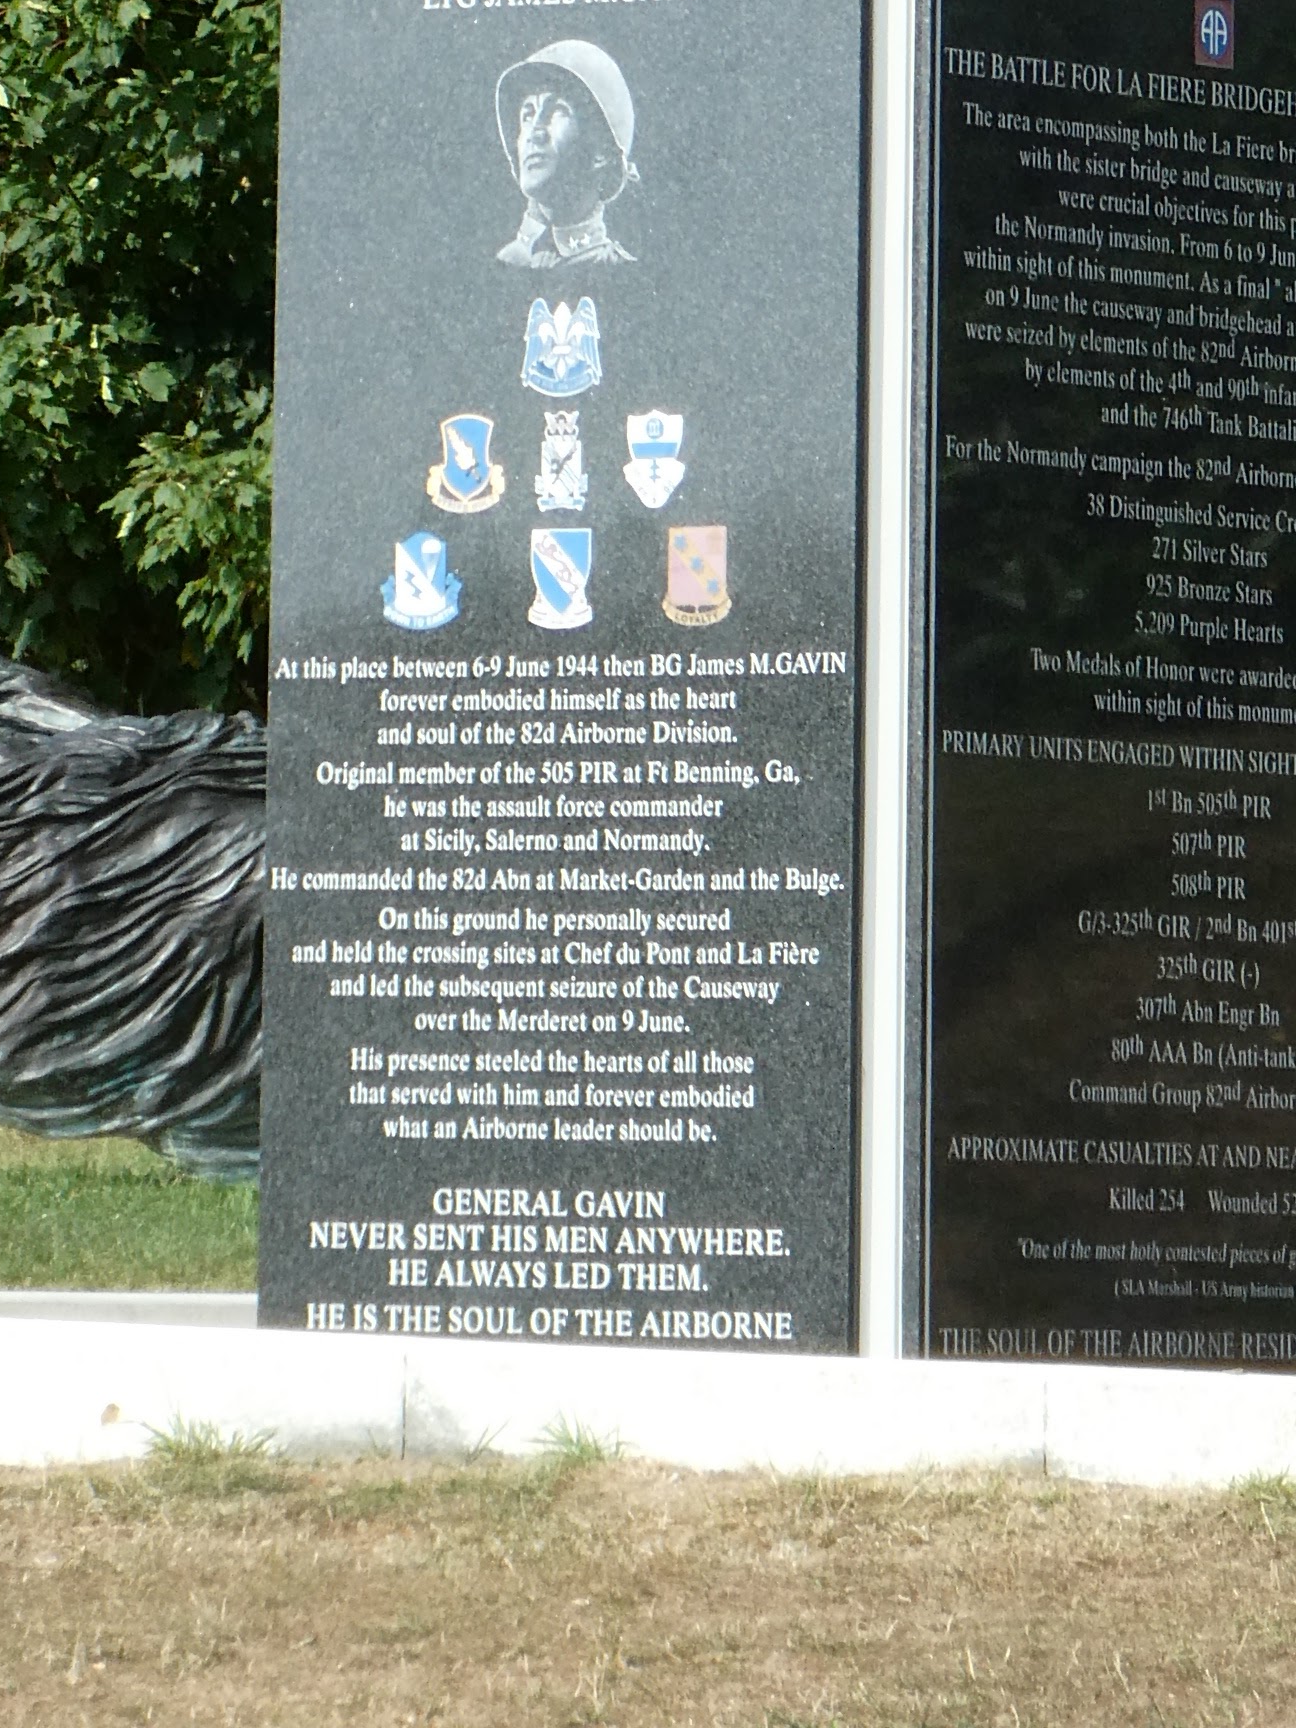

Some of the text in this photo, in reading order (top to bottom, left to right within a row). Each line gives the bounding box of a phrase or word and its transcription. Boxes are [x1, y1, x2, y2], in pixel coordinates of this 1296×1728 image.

[1201, 9, 1228, 55] AA
[945, 47, 985, 78] THE
[991, 53, 1065, 87] BATTLE
[1072, 63, 1111, 93] FOR
[1117, 68, 1142, 97] LA
[1148, 72, 1205, 105] FIERE
[1058, 190, 1094, 210] were
[1099, 191, 1149, 216] crucial
[1154, 195, 1228, 225] objectives
[1233, 204, 1254, 228] for
[1259, 207, 1285, 231] this
[1101, 402, 1128, 424] and
[1133, 404, 1157, 428] the
[1163, 406, 1202, 430] 746th
[1207, 411, 1242, 436] Tank
[1087, 492, 1104, 516] 38
[1110, 494, 1212, 528] Distinguished
[1217, 504, 1270, 531] Service
[1152, 536, 1267, 567] 271 Silver Stars
[1146, 573, 1272, 605] 925 Bronze Stars
[675, 612, 718, 624] LOYALTY
[1135, 610, 1283, 645] 5,209 Purple Hearts
[274, 651, 846, 684] At this place between 6-9 June 1944 then BG James M.GAVIN
[379, 686, 736, 712] forever embodied himself as the heart
[1094, 689, 1141, 713] within
[1146, 692, 1181, 722] sight
[1186, 695, 1203, 718] of
[1207, 696, 1233, 719] this
[377, 718, 737, 745] and soul of the 82d Airborne Division.
[1148, 788, 1271, 819] 1st Bn 505th PIR
[1172, 829, 1246, 858] 507th PIR
[271, 866, 844, 896] He commanded the 82d Abn at Market-Garden and the Bulge.
[1171, 871, 1245, 900] 508th PIR
[378, 906, 730, 936] On this ground he personally secured
[1136, 994, 1279, 1031] 307th Abn Engr Bn
[1111, 1034, 1143, 1061] 80th
[1149, 1040, 1187, 1064] AAA
[1193, 1041, 1212, 1065] Bn
[1069, 1078, 1146, 1103] Command
[1152, 1081, 1201, 1113] Group
[1206, 1083, 1240, 1106] 82nd
[383, 1114, 716, 1142] what an Airborne leader should be.
[432, 1187, 664, 1218] GENERAL GAVIN
[1110, 1187, 1154, 1210] Killed
[1159, 1188, 1184, 1211] 254
[1208, 1190, 1277, 1214] Wounded
[310, 1221, 790, 1256] NEVER SENT HIS MEN ANYWHERE.
[389, 1258, 708, 1292] HE ALWAYS LED THEM.
[306, 1302, 792, 1337] HE IS THE SOUL OF THE AIRBORNE
[939, 1328, 979, 1355] THE
[987, 1328, 1041, 1356] SOUL
[1048, 1329, 1075, 1356] OF
[1080, 1330, 1122, 1358] THE
[1128, 1331, 1234, 1358] AIRBORNE
